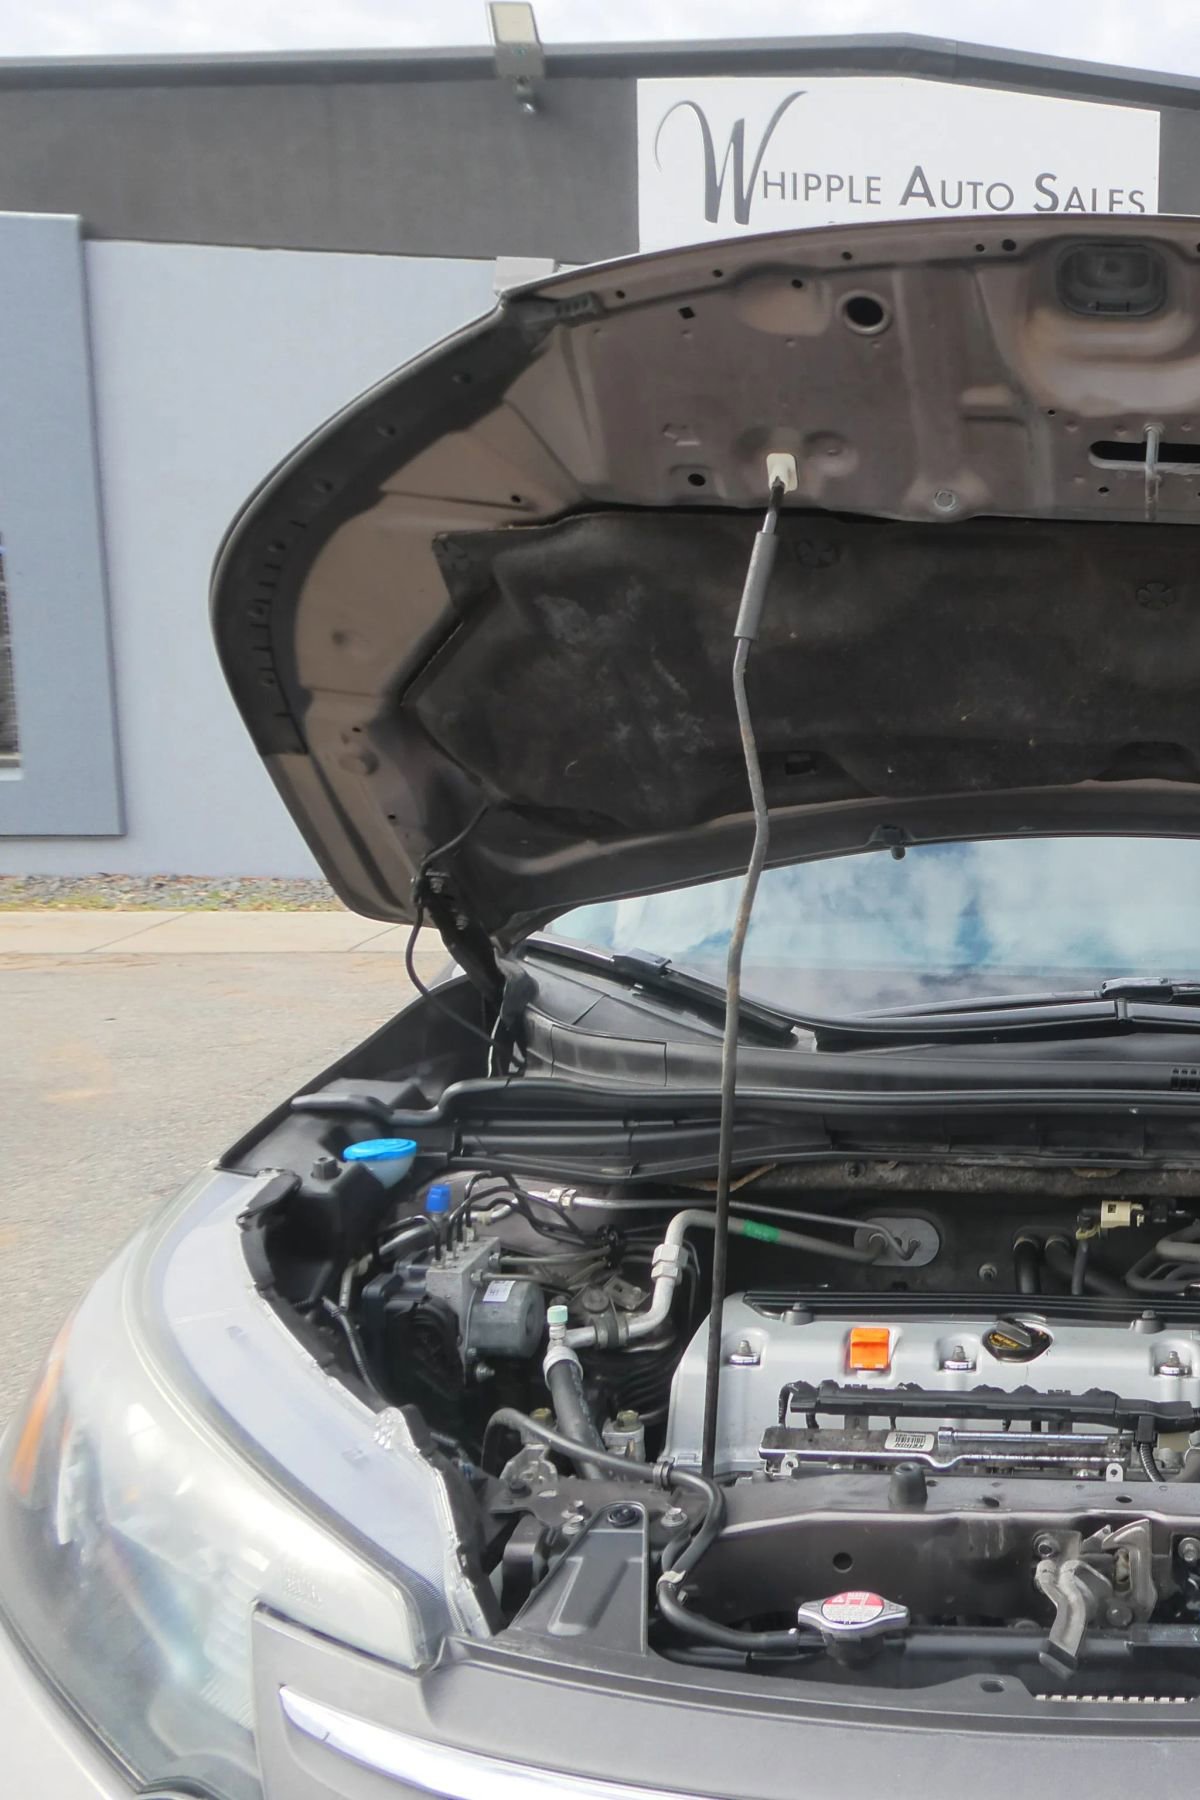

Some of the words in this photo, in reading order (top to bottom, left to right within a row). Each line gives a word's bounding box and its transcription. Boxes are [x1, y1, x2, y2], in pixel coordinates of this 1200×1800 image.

[654, 90, 882, 225] WHIPPLE
[899, 165, 1015, 212] AUTO
[1033, 173, 1146, 213] SALES
